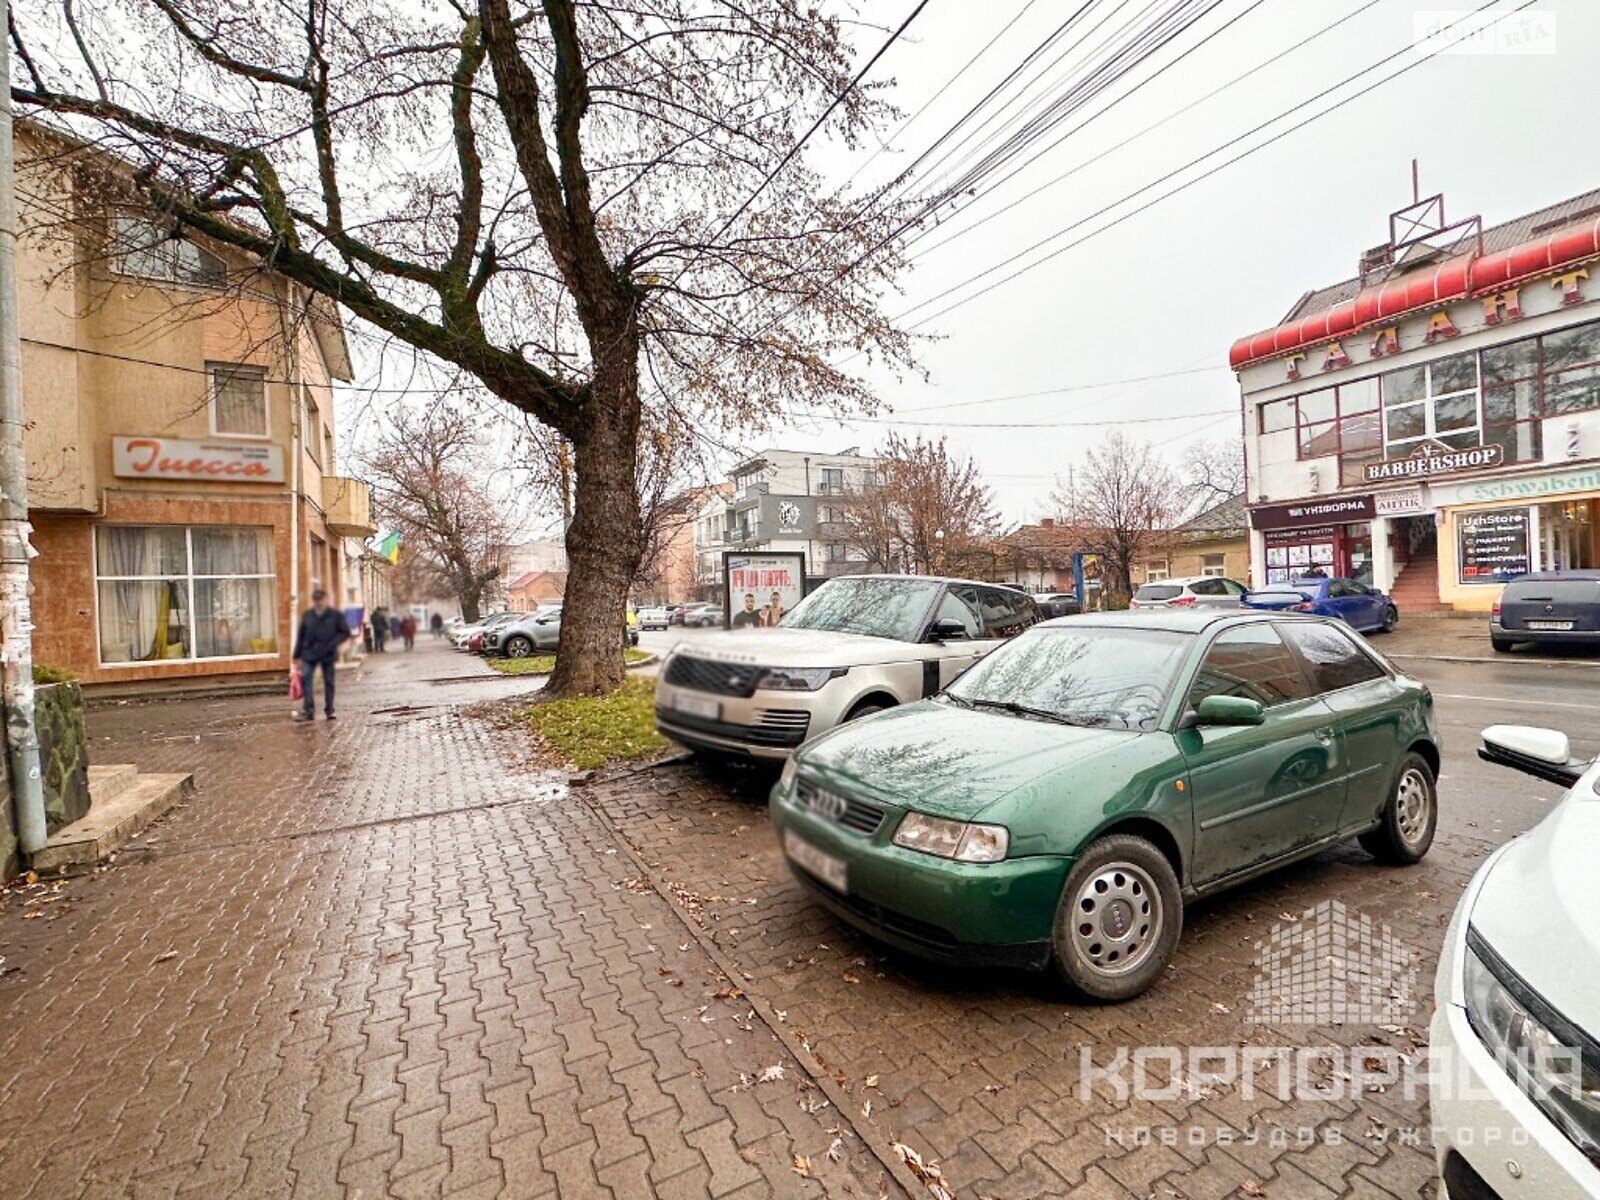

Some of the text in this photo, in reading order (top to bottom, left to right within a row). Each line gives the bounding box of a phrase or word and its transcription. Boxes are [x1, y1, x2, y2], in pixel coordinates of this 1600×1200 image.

[1283, 267, 1589, 381] ТАЛАНТ
[1368, 449, 1497, 479] BARBERSHOP
[1304, 500, 1366, 515] УНІФОРМА
